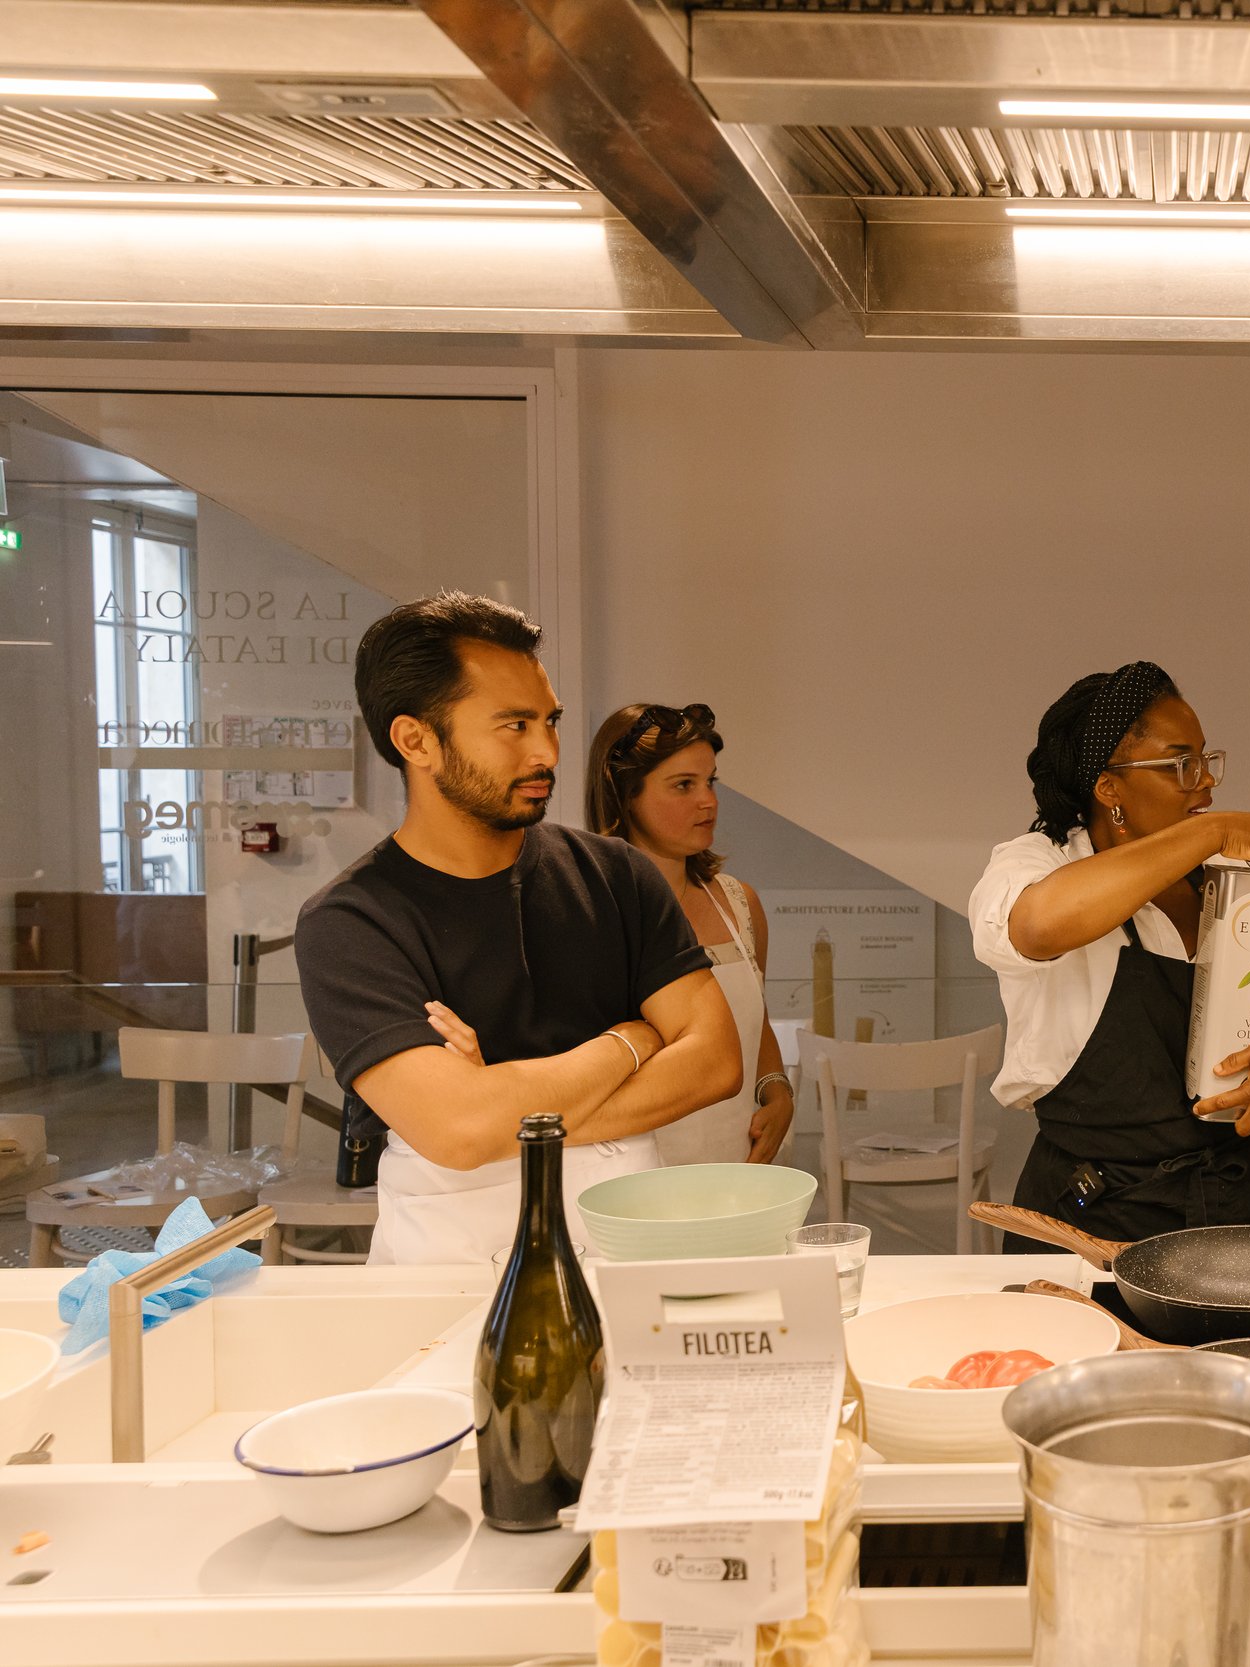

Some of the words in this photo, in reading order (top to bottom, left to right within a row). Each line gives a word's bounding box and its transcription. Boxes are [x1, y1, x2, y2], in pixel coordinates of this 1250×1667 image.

[774, 905, 855, 914] ARCHITECTURE
[857, 905, 921, 914] EATALIENNE
[683, 1331, 773, 1355] FILOTEA
